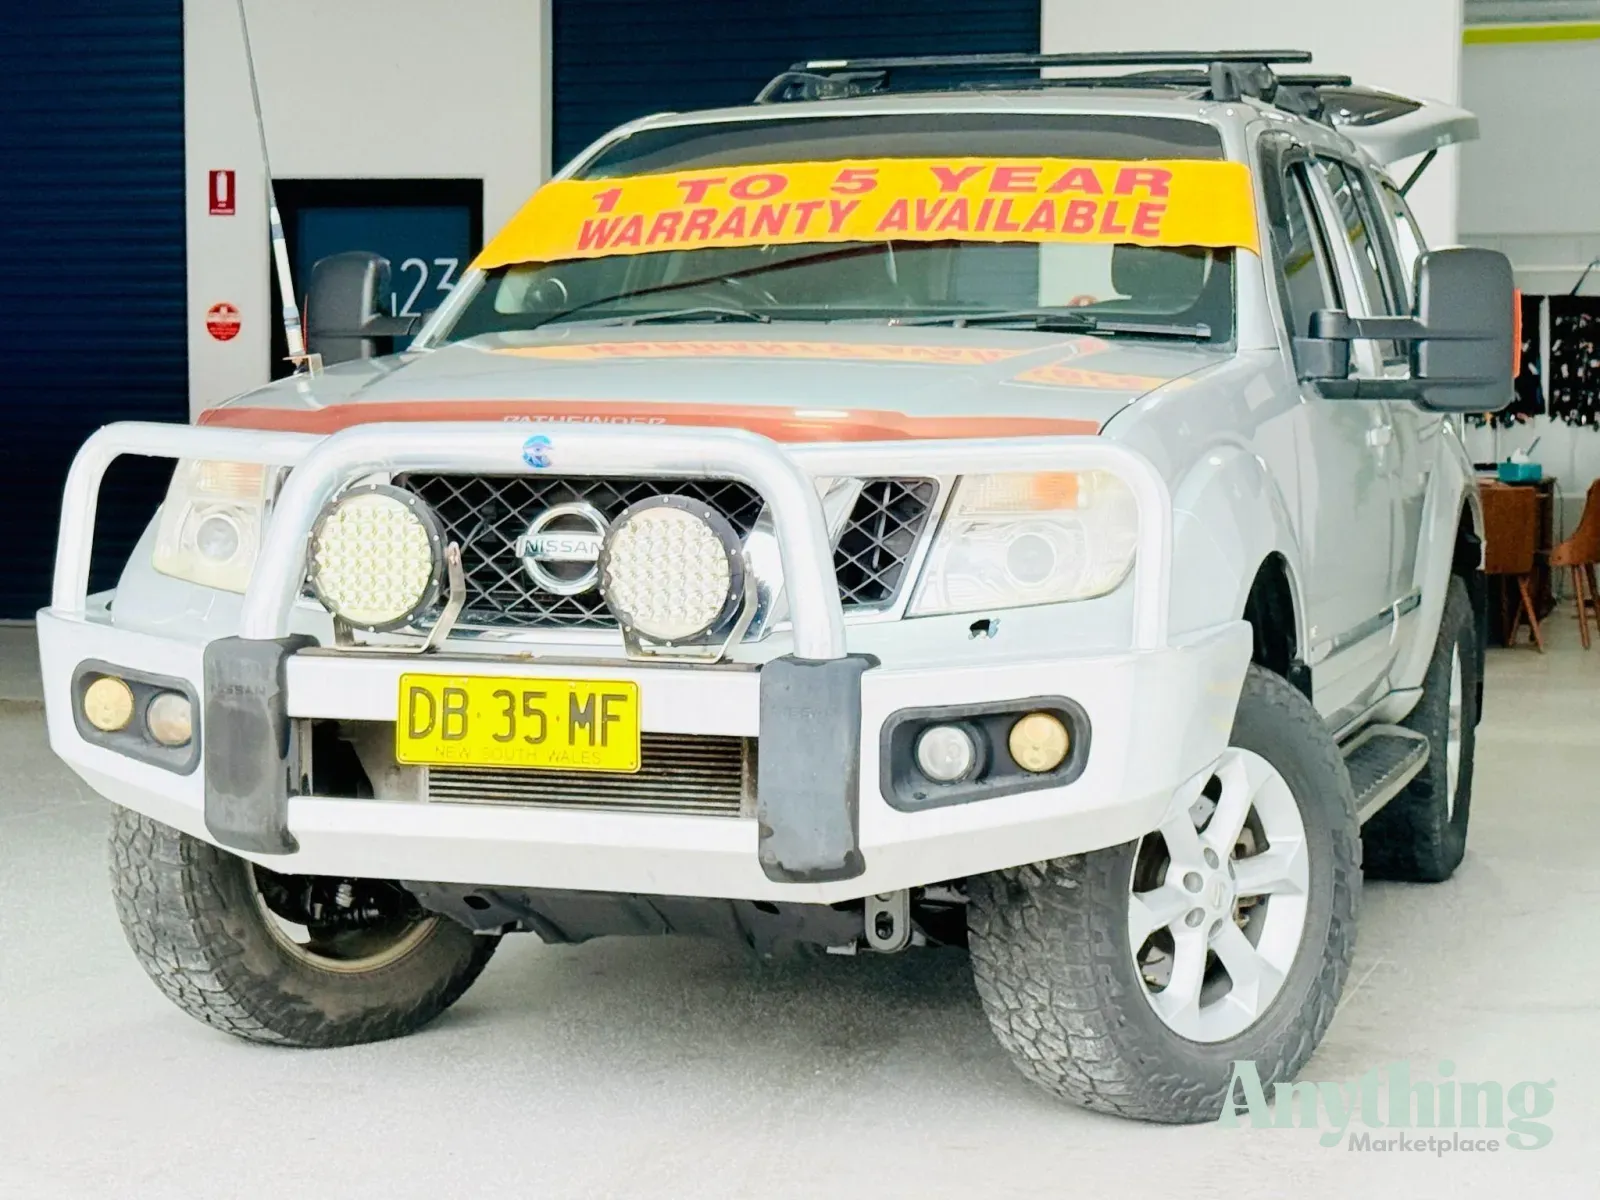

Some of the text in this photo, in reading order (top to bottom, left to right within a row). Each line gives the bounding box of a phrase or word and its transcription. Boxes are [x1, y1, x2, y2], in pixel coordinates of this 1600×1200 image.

[592, 166, 1173, 213] 1 TO 5 YEAR
[577, 198, 1167, 250] WARRANTY AVAILABLE
[435, 746, 602, 765] NEW SOUTH WALES
